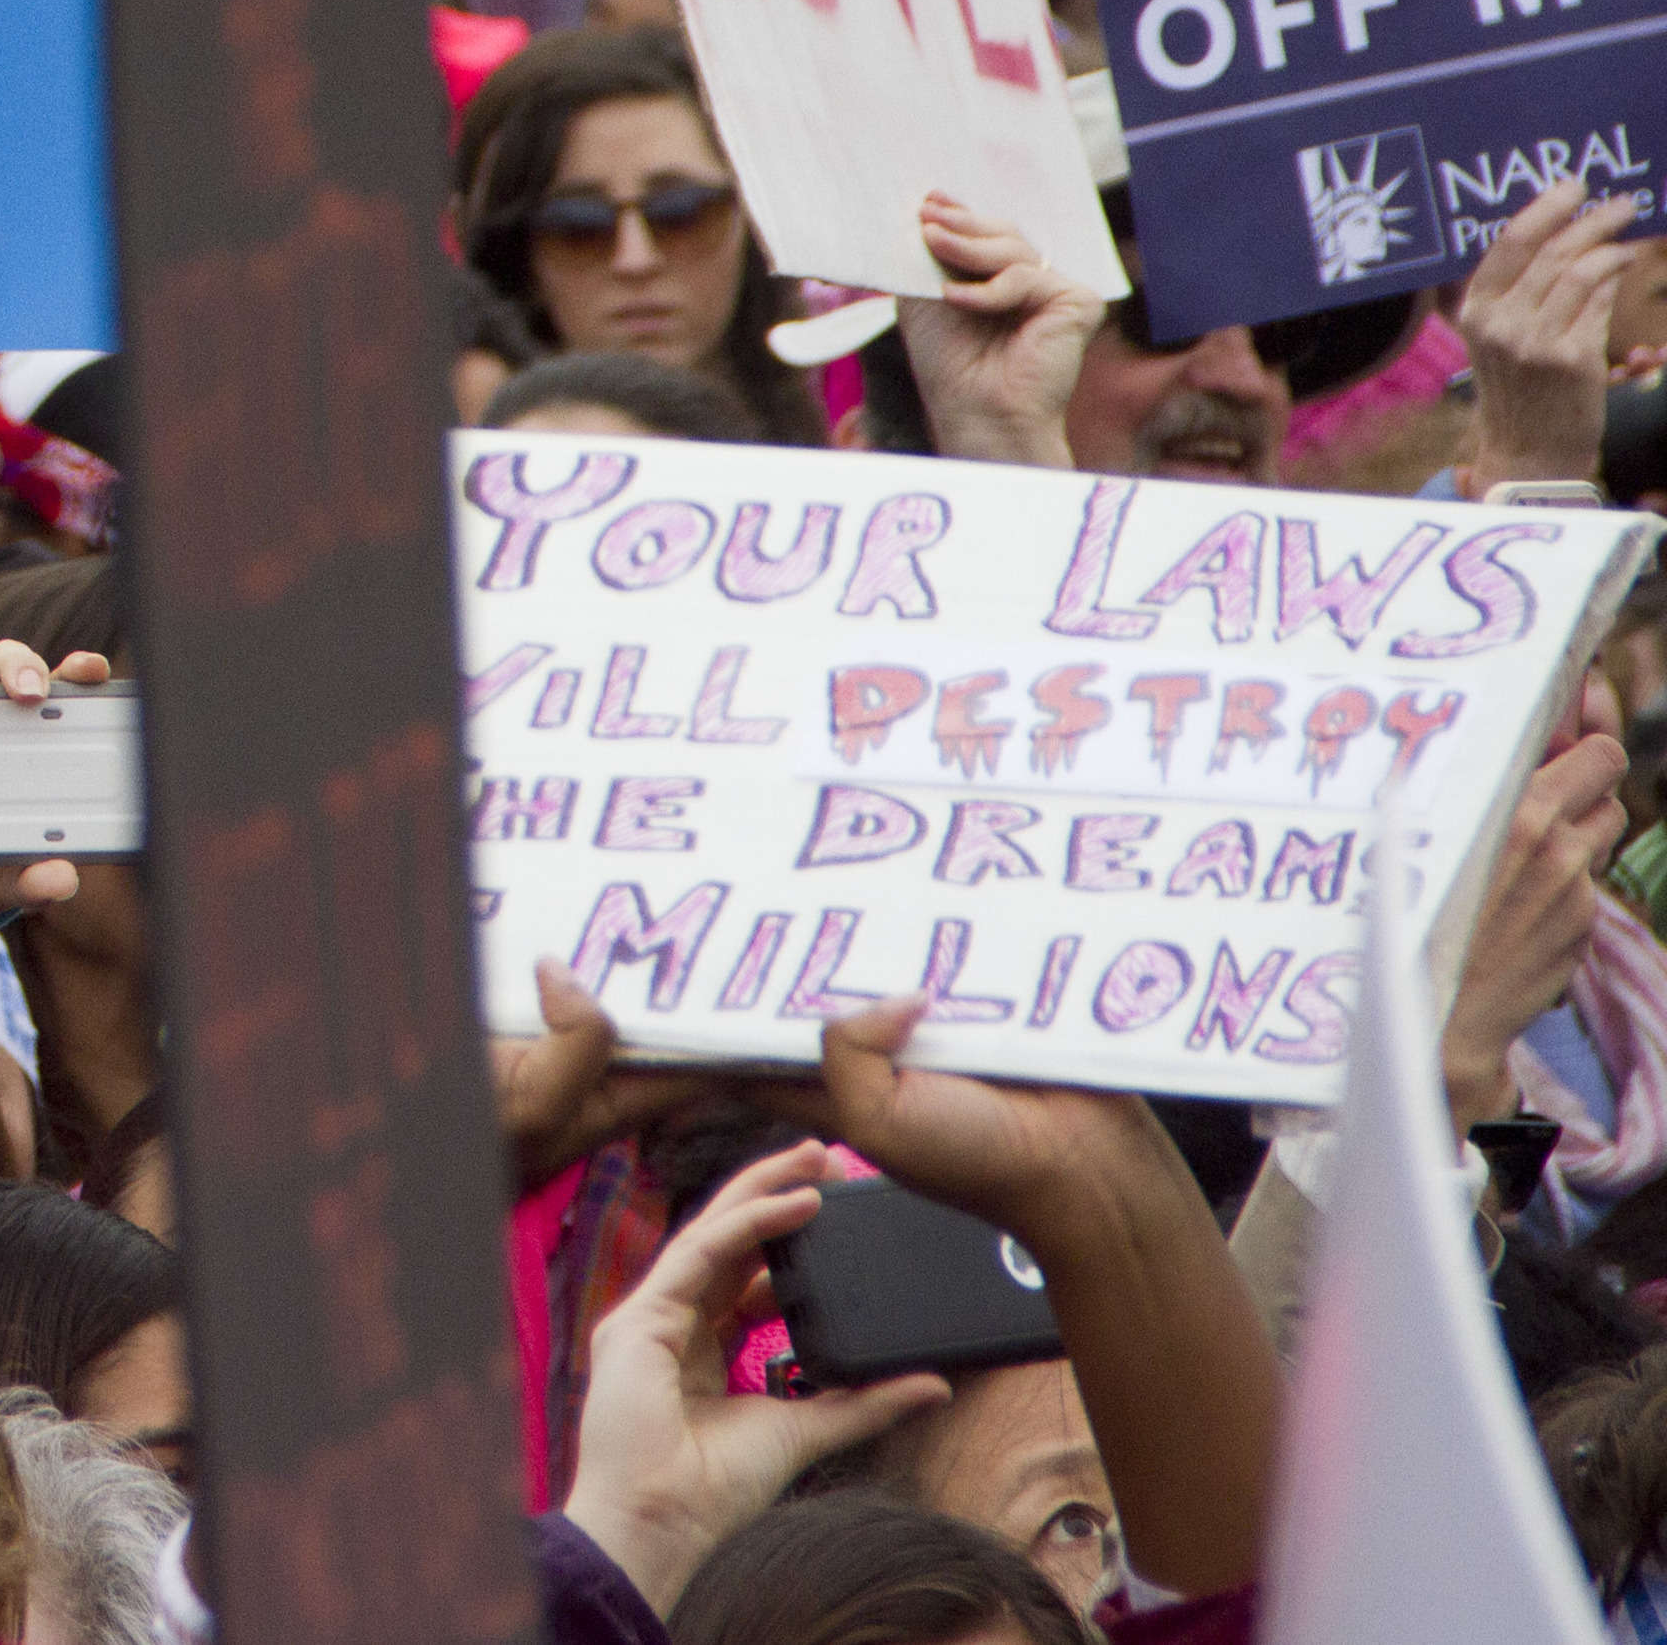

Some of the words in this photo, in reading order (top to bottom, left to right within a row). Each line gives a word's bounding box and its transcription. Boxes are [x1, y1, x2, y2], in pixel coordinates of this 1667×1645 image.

[1439, 123, 1650, 212] NARAL
[466, 451, 952, 619] YOUR
[1043, 477, 1563, 659] LAWS
[826, 660, 1467, 799] DESTROY
[468, 756, 706, 852] HE
[570, 882, 1365, 1065] MILLIONS
